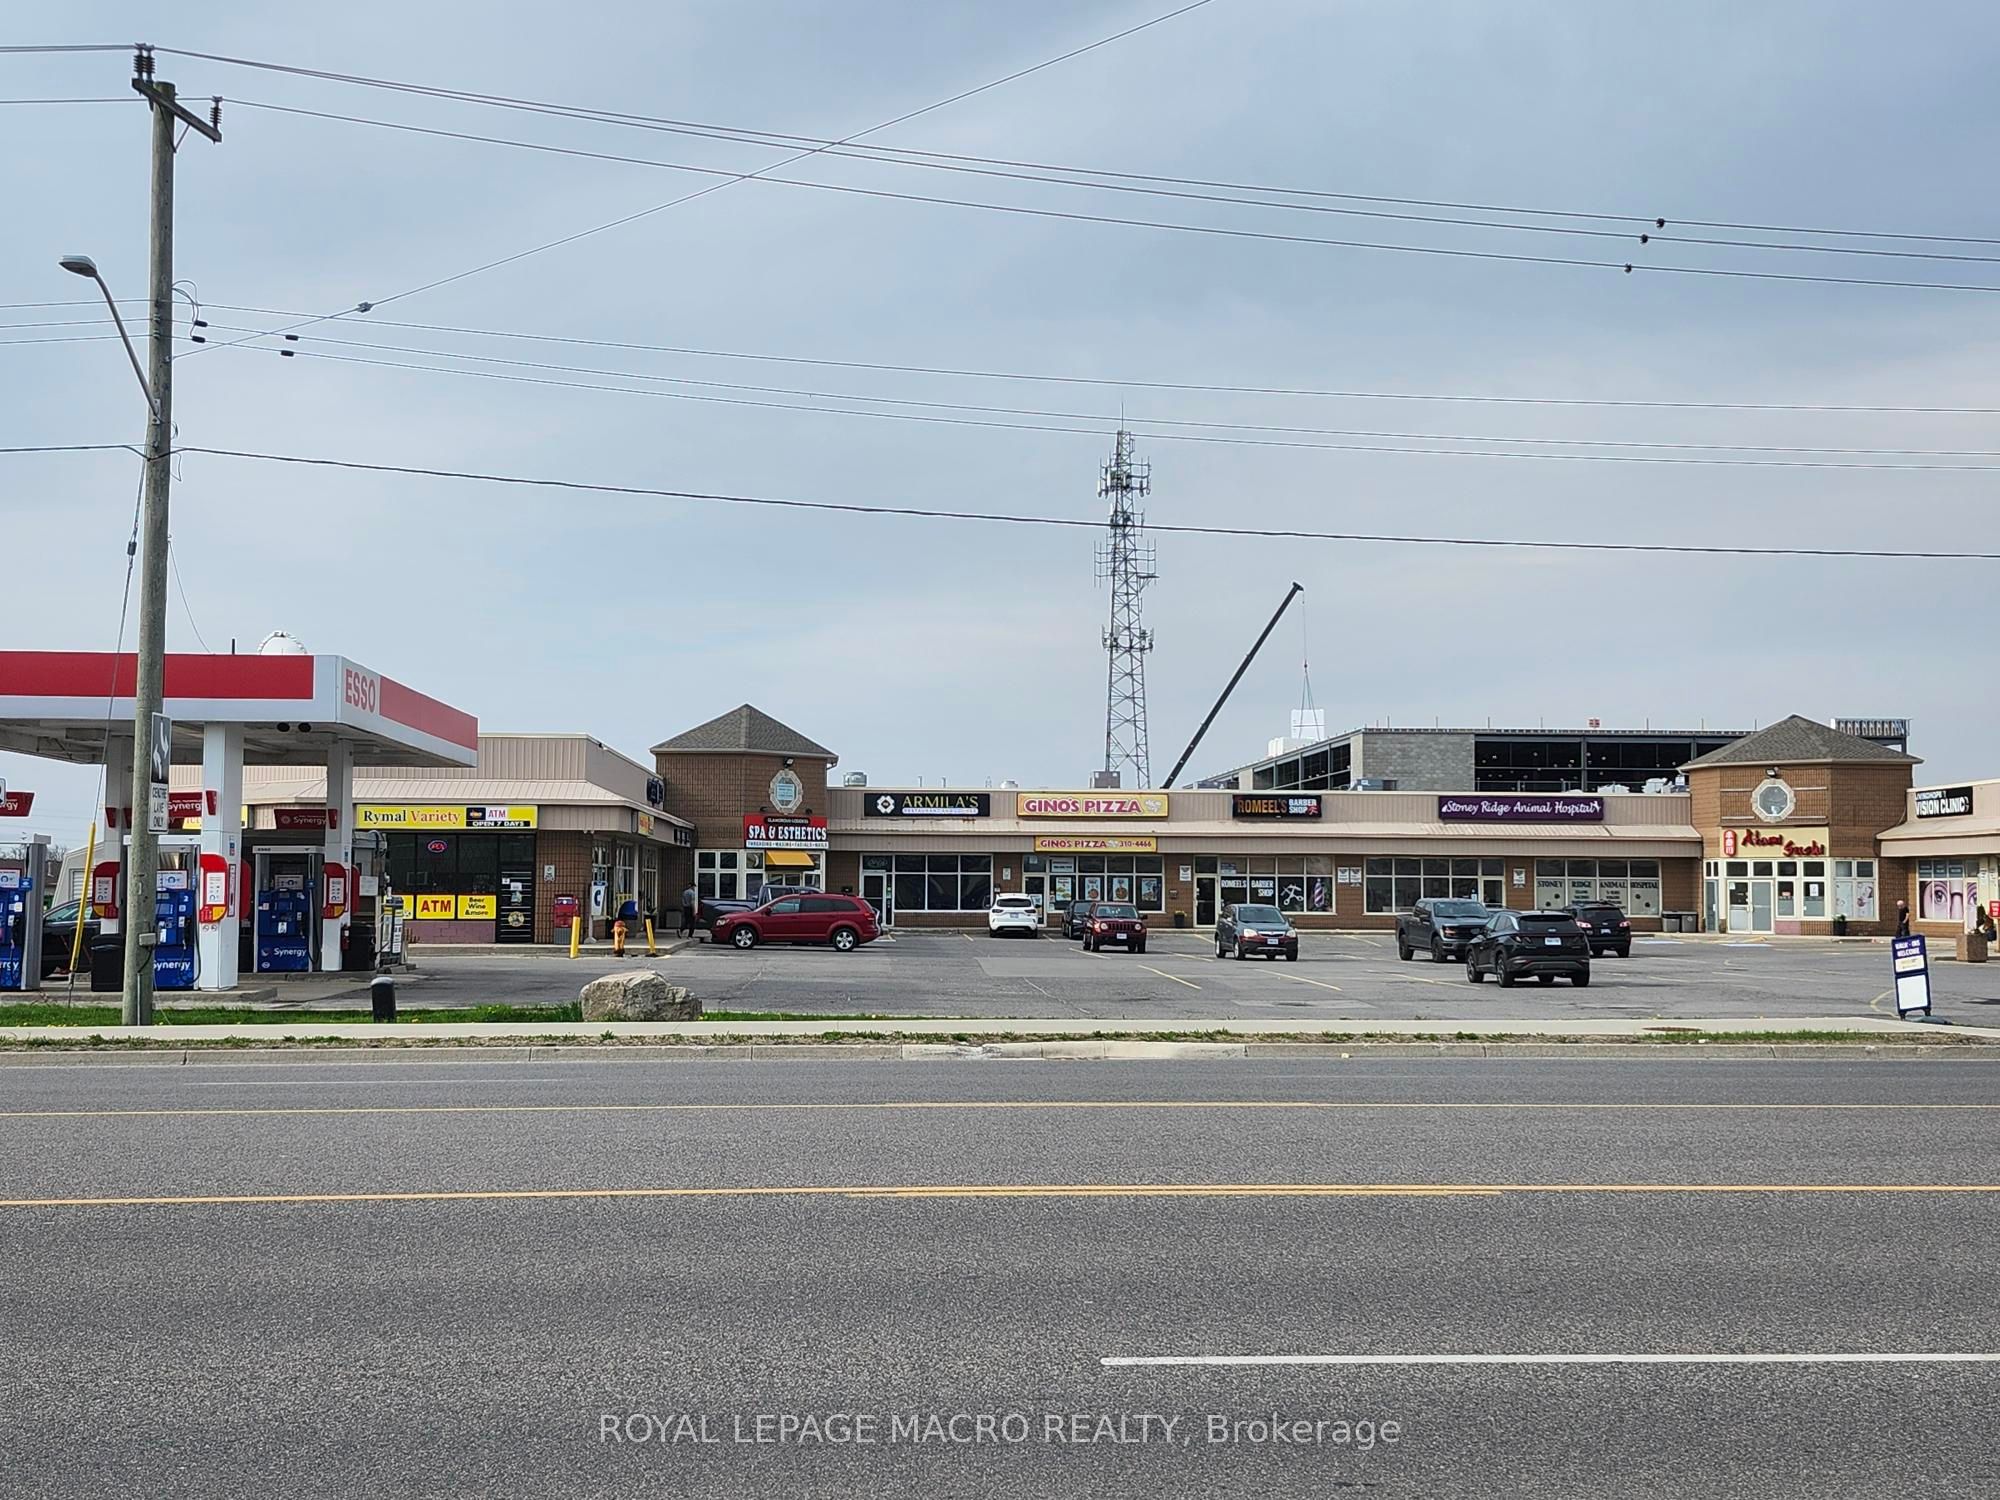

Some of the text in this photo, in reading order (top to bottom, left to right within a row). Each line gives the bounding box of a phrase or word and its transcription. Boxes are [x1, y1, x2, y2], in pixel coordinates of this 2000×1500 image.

[345, 668, 376, 713] ESSO
[902, 795, 979, 808] ARMILA'S
[1025, 798, 1142, 813] GINO'S PIZZA
[1237, 798, 1317, 813] ROMEEL'S BARBER
[1447, 800, 1594, 816] Stoney Ridge Animal Hospital
[1916, 797, 1965, 816] VISION CLINIC
[363, 809, 506, 825] Rymal Variety ATM
[1288, 806, 1308, 814] SHOP
[748, 824, 827, 840] SPA & ESTHETICS
[1074, 839, 1107, 848] PIZZA
[1537, 880, 1563, 888] STONEY
[1258, 889, 1274, 897] SHOP
[420, 900, 451, 913] ATM
[274, 947, 307, 957] Synergy
